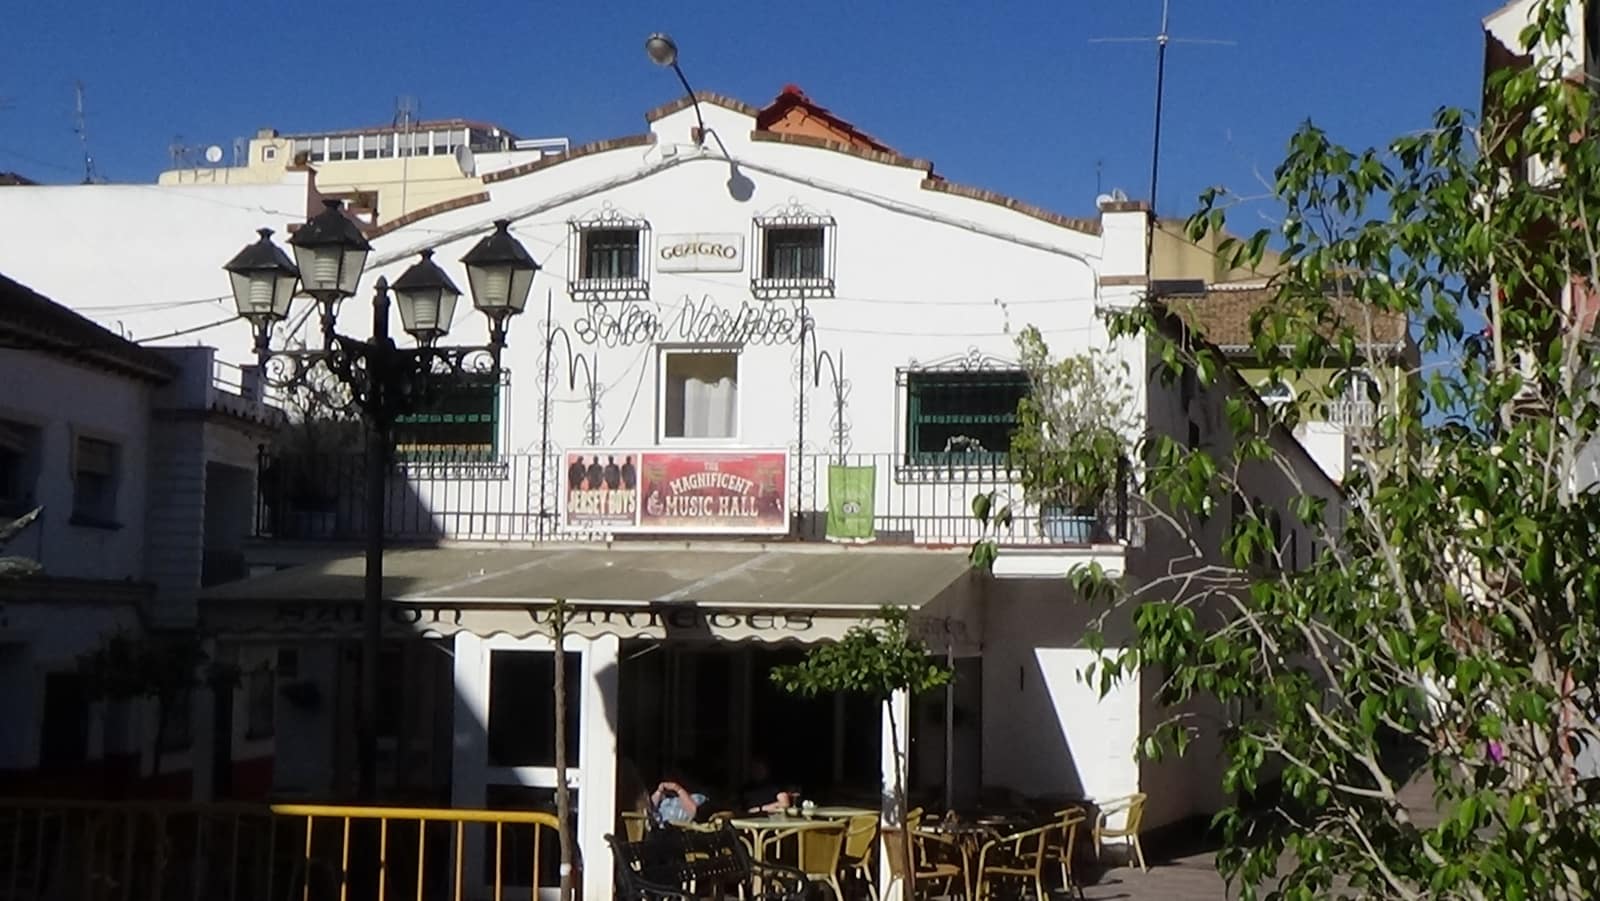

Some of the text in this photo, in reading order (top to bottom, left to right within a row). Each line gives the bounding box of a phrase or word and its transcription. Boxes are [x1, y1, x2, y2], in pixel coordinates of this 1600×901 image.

[669, 472, 755, 496] MAGNIFICENT
[567, 489, 636, 514] JERSEY BOYS
[665, 495, 759, 517] MUSIC HALL
